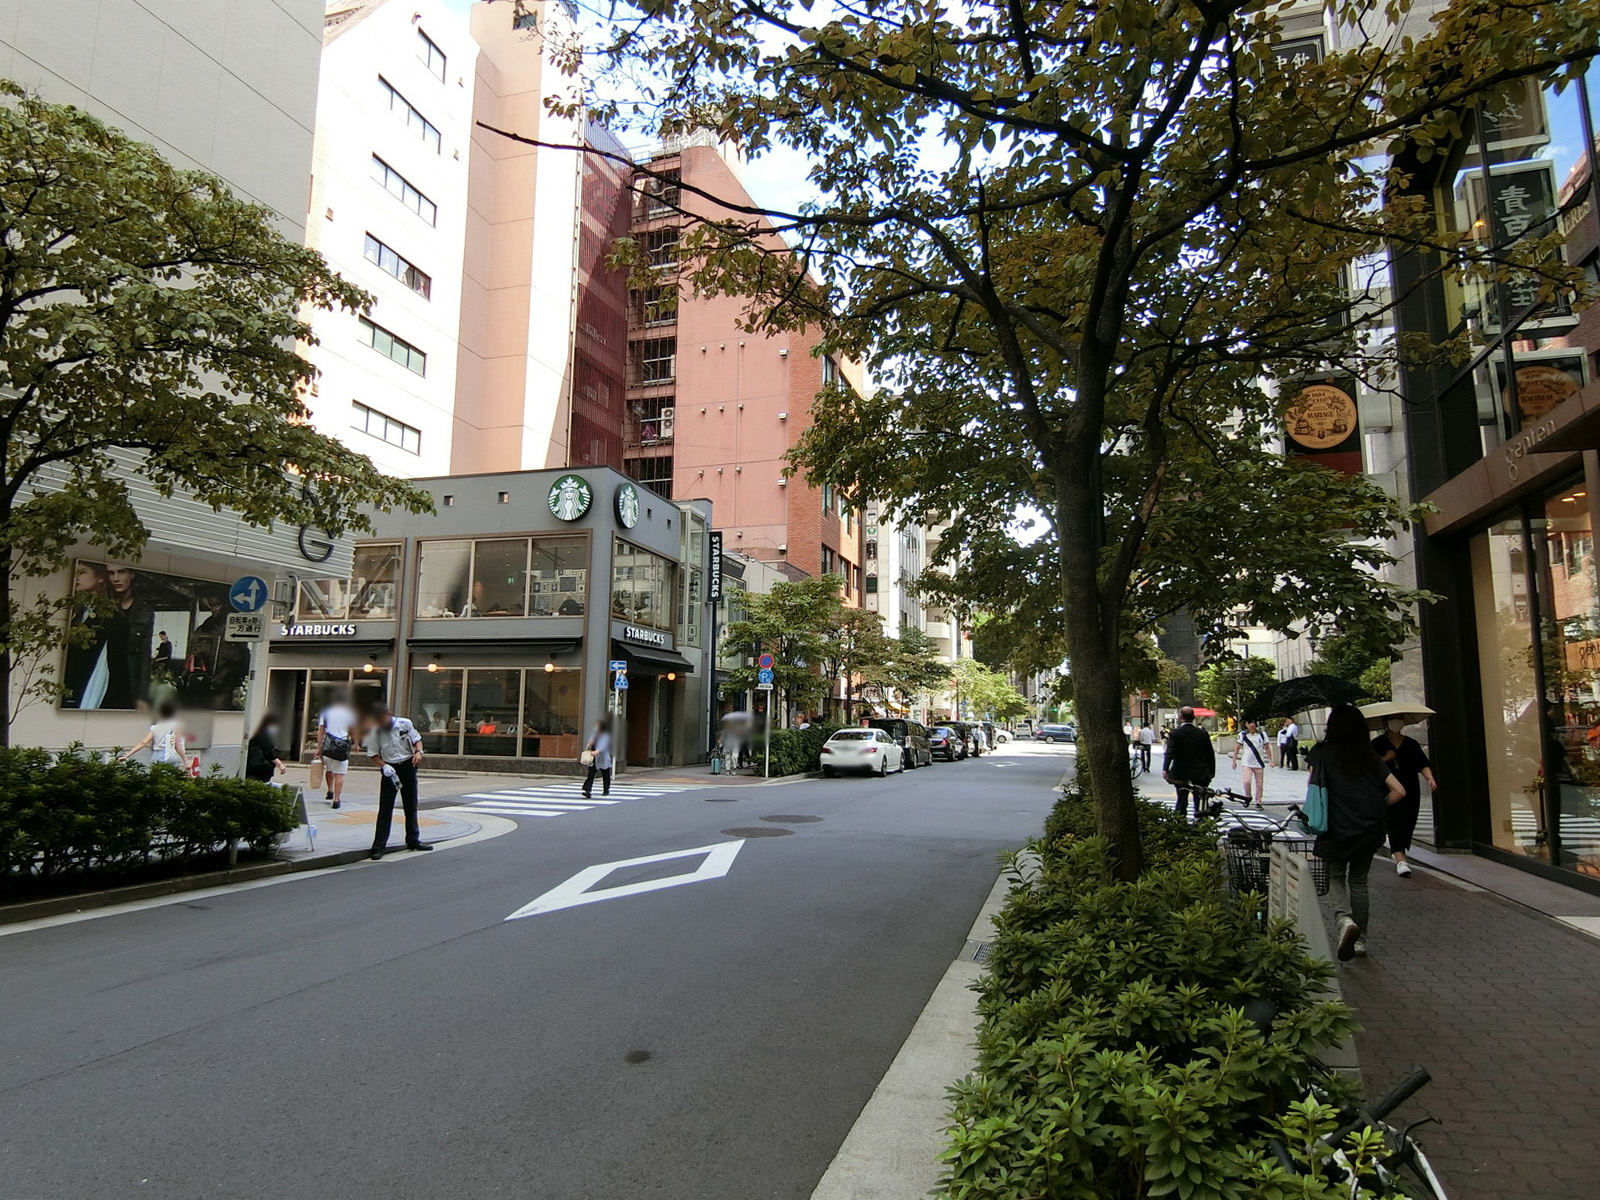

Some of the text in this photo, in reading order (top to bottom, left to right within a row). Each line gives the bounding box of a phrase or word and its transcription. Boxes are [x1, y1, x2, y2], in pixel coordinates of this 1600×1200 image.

[1506, 420, 1556, 480] genten
[711, 535, 720, 599] STARBUCKS
[228, 624, 262, 632] 一方通行
[281, 624, 356, 637] STARBUCKS
[626, 626, 664, 644] STARBUCKS
